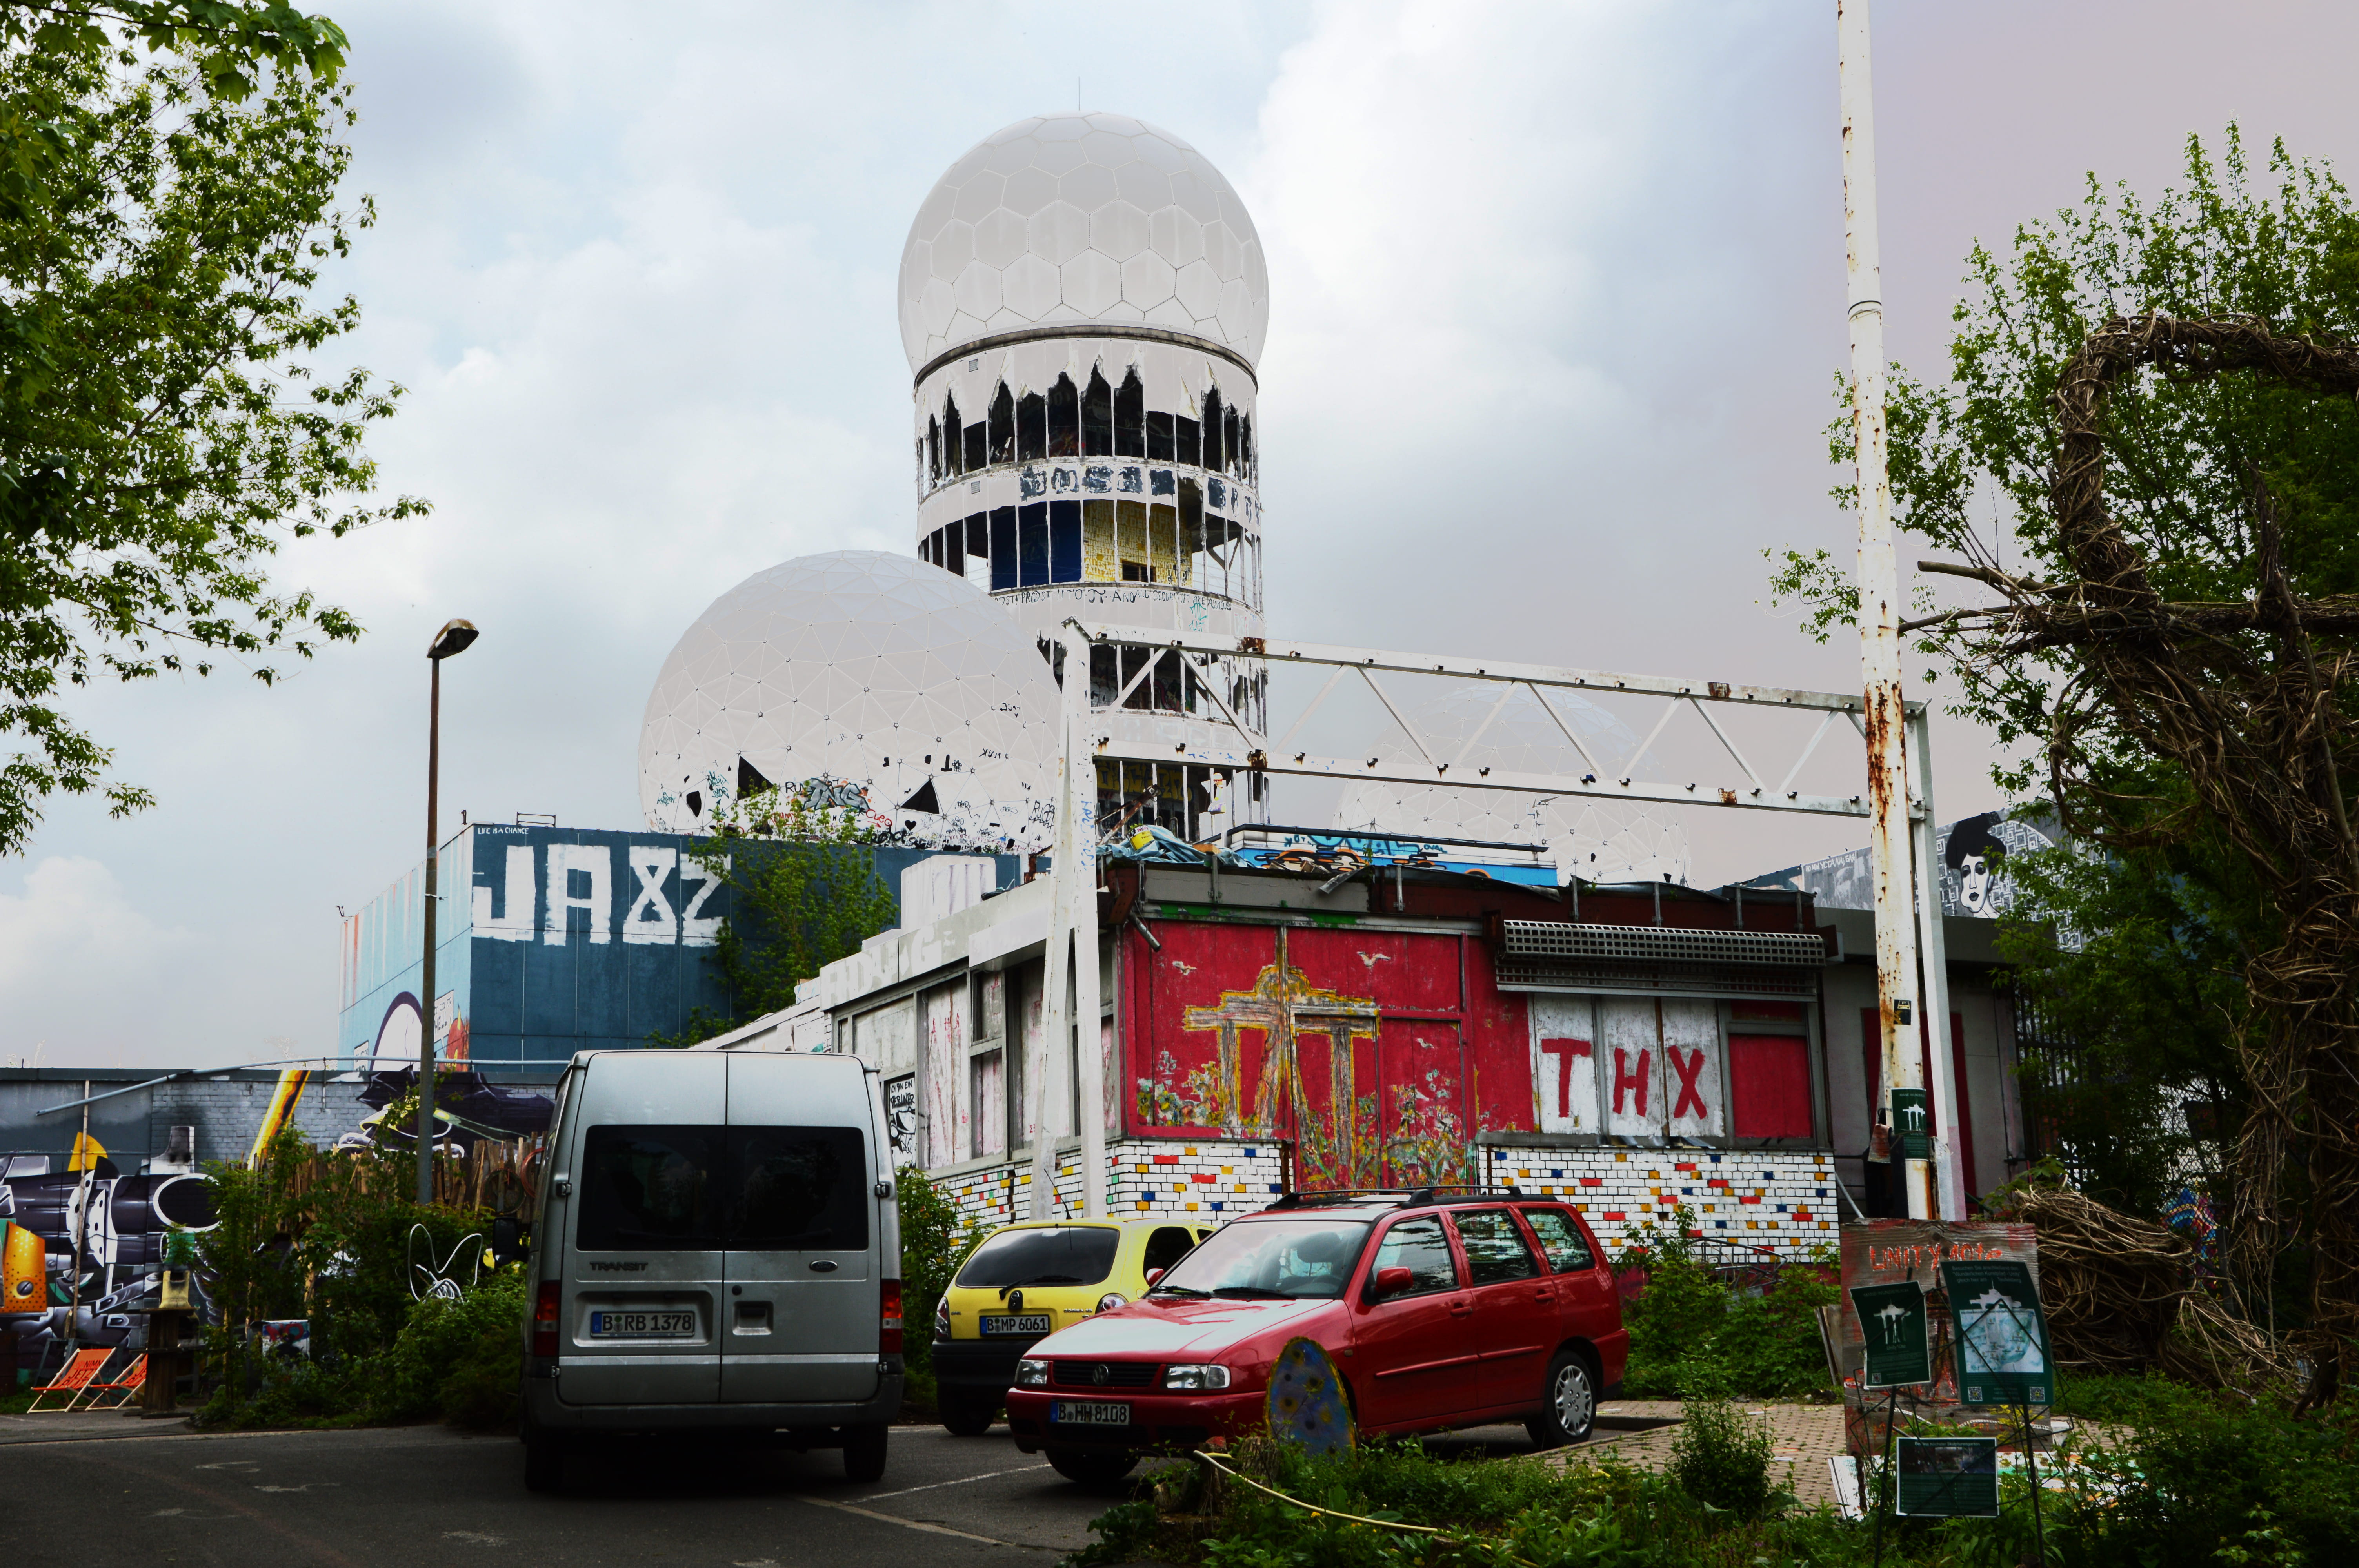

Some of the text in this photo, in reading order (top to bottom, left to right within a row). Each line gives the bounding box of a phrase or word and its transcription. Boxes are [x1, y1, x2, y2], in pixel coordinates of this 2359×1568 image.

[1423, 844, 1447, 853] OVAL
[905, 1079, 913, 1090] EIN
[1541, 1038, 1707, 1120] THX
[1869, 1242, 1941, 1272] UNITY
[589, 1262, 648, 1271] TRANSIT
[602, 1315, 613, 1331] B
[625, 1315, 646, 1331] RB
[650, 1315, 692, 1331] 1378
[987, 1318, 994, 1330] B
[1001, 1318, 1016, 1331] MP
[1018, 1318, 1047, 1331] 6061
[1058, 1403, 1066, 1420] B
[1095, 1405, 1127, 1423] 8108
